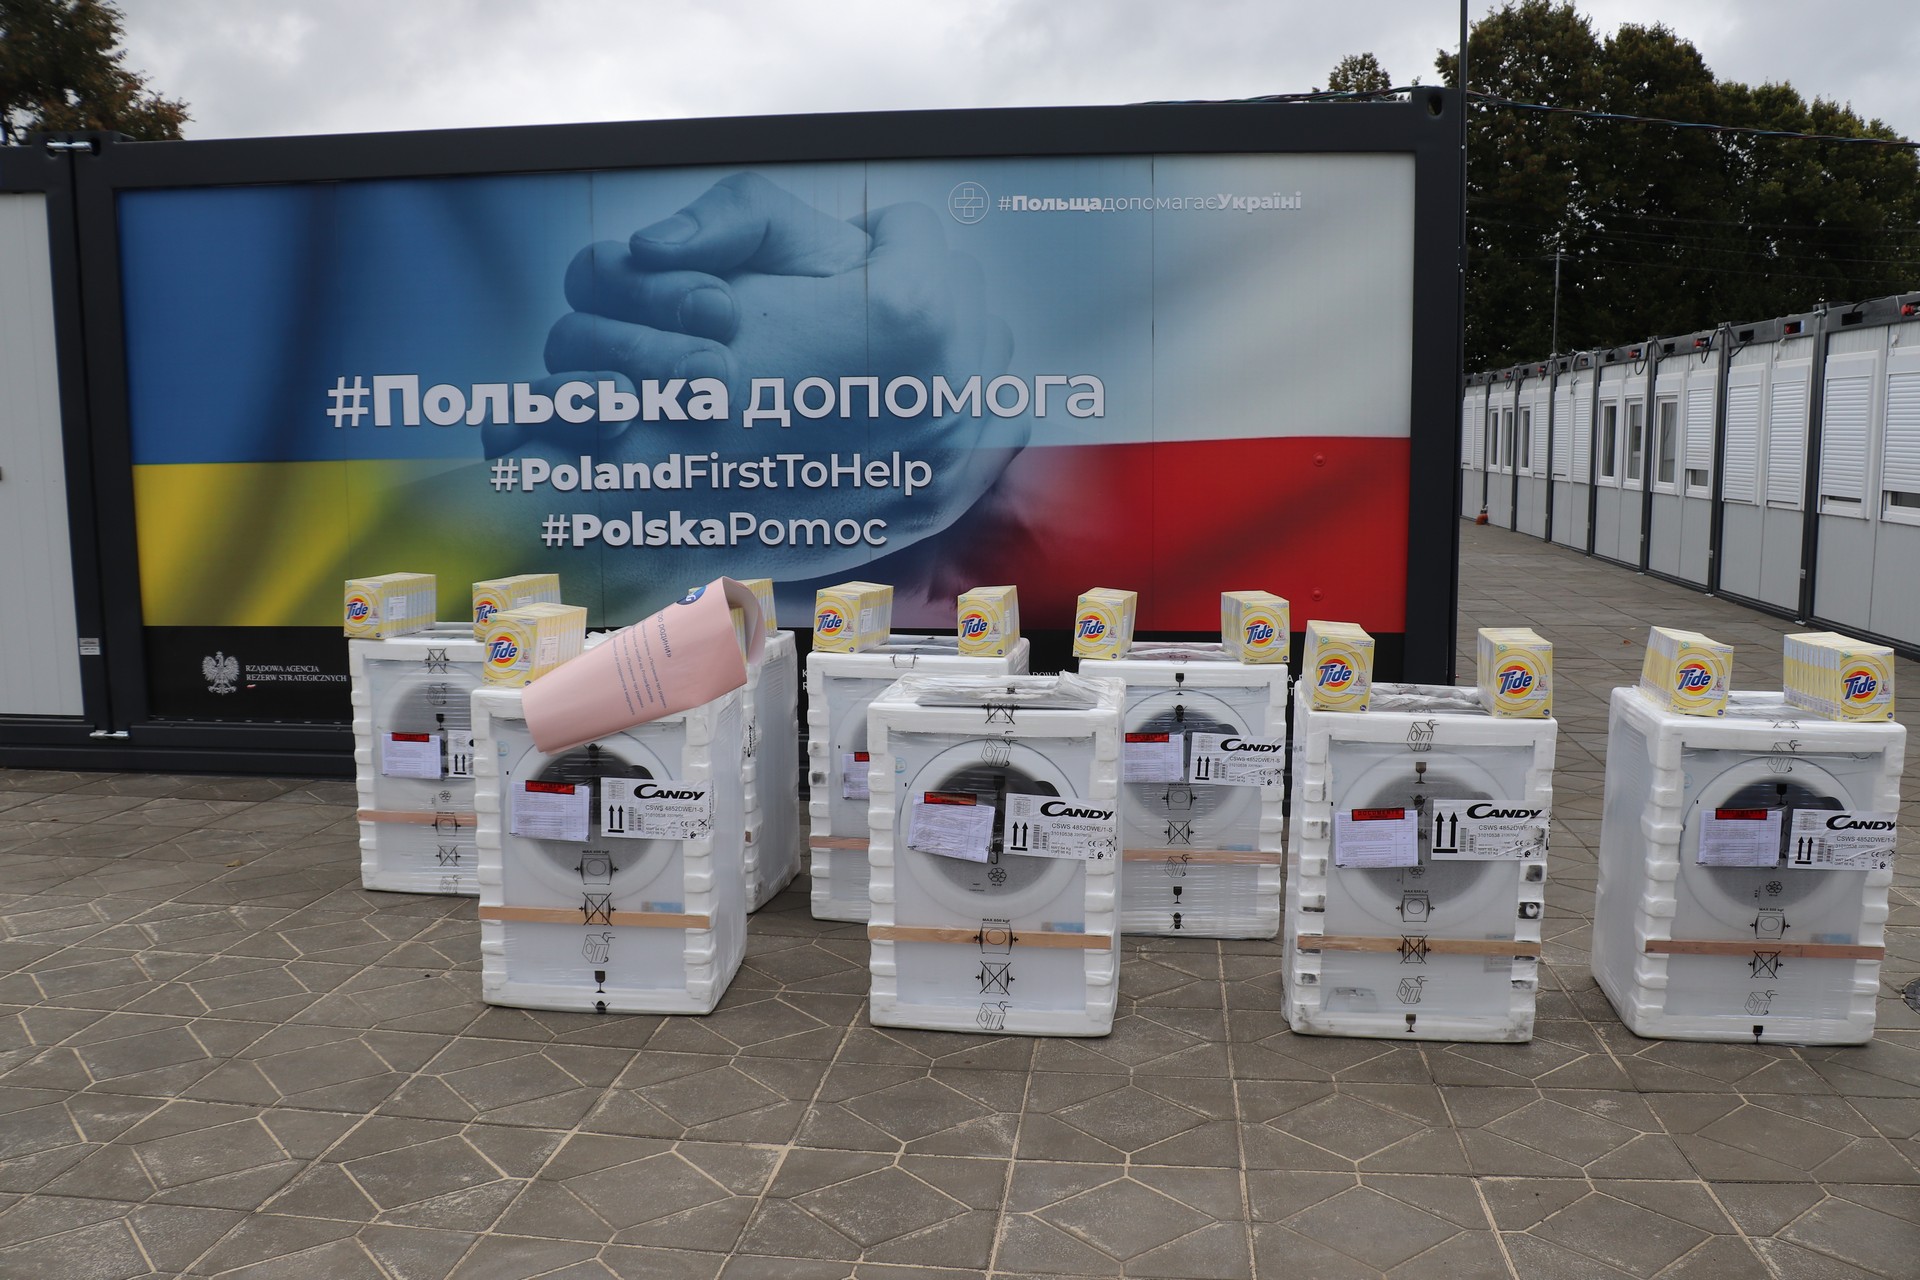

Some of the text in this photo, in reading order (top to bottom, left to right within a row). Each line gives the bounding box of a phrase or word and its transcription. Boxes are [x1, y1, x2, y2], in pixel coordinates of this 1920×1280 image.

[997, 191, 1302, 214] #ПольщадопомагаєУкраїні
[326, 372, 1106, 428] #Польська допомога
[490, 452, 933, 496] #PolandFirstToHelp
[541, 511, 888, 548] #PolskaPomoc
[346, 602, 369, 620] Tide
[817, 613, 843, 632] Tide
[961, 619, 988, 638] Tide
[1078, 619, 1106, 638] Tide
[1246, 624, 1274, 644] Tide
[487, 640, 518, 662] Tide
[245, 665, 319, 674] RZĄDOWA AGENCJA
[278, 674, 347, 682] STRATEGICZNYCH
[1318, 664, 1353, 687] Tide
[1677, 669, 1712, 690] Tide
[1499, 671, 1534, 694] Tide
[1843, 676, 1877, 700] Tide
